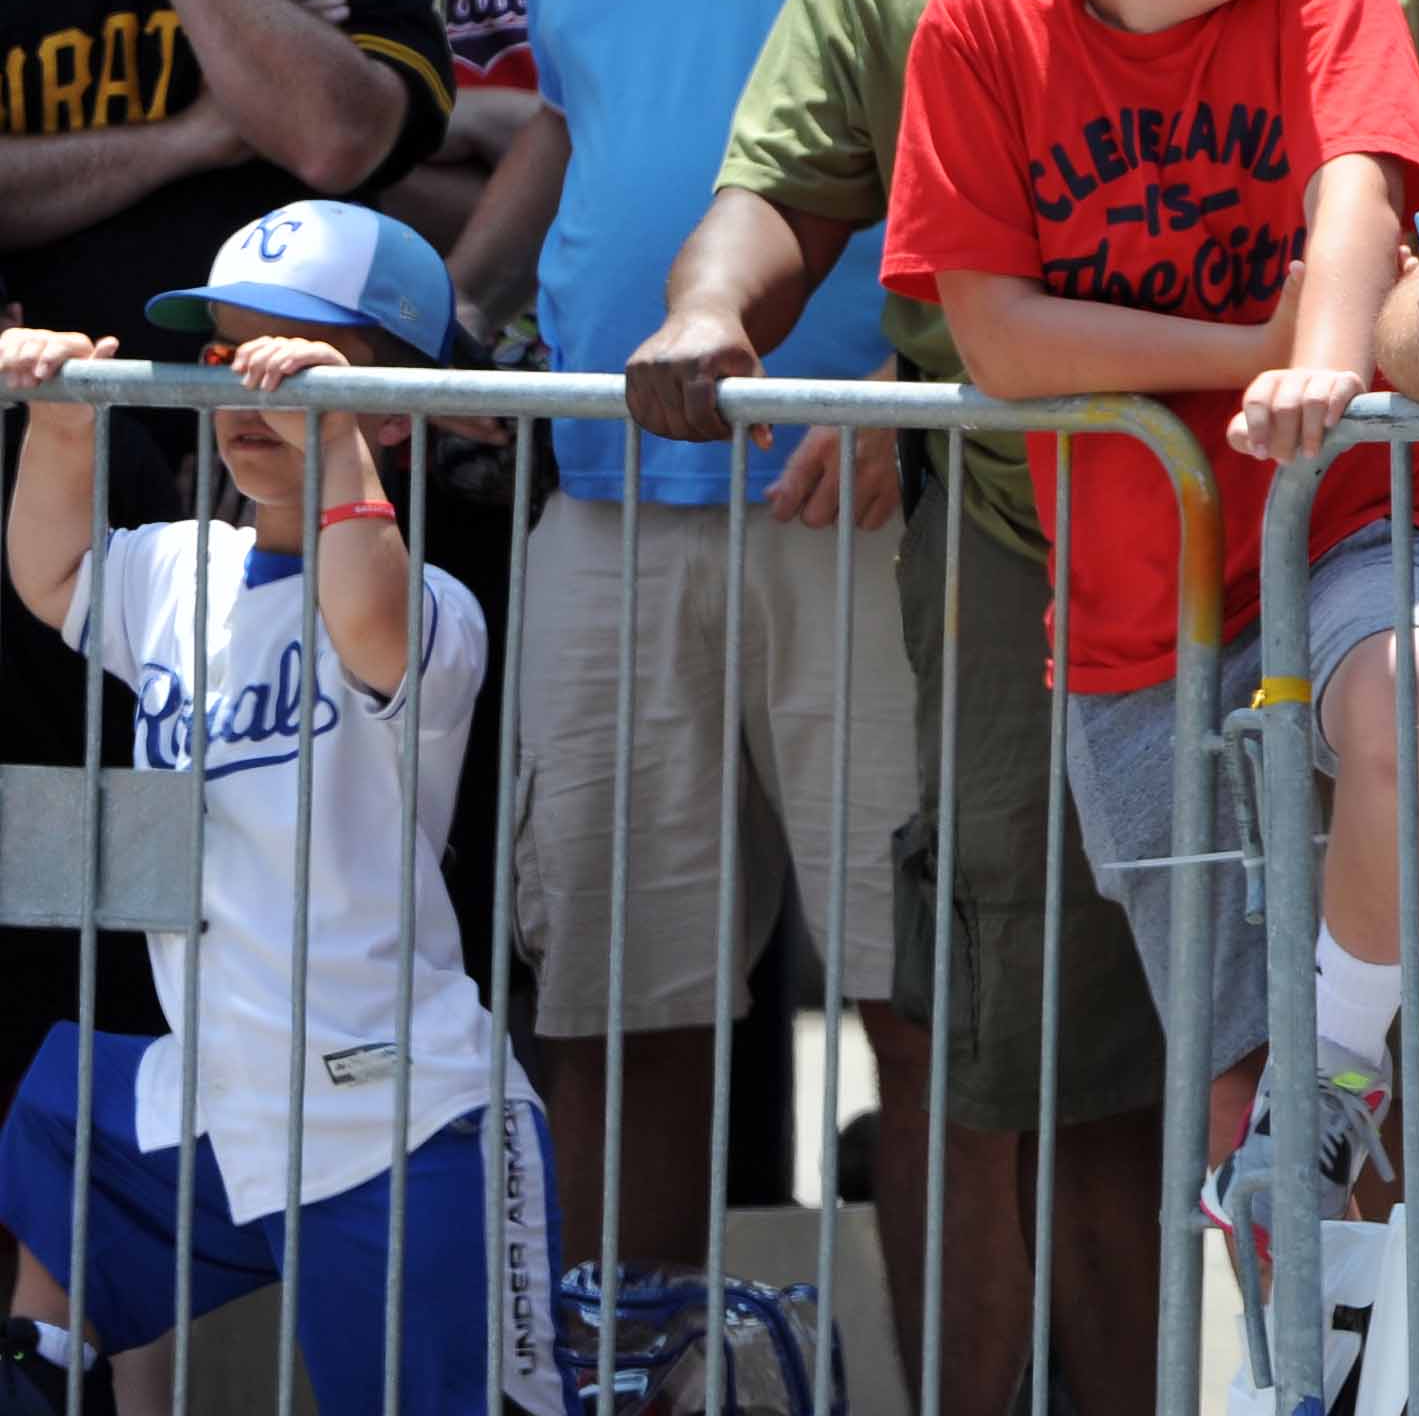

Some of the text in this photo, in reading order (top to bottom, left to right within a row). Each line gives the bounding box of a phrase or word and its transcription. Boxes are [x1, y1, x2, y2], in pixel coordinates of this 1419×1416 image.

[241, 211, 303, 264] KC
[1043, 238, 1188, 312] The
[509, 1241, 537, 1376] UNDER
